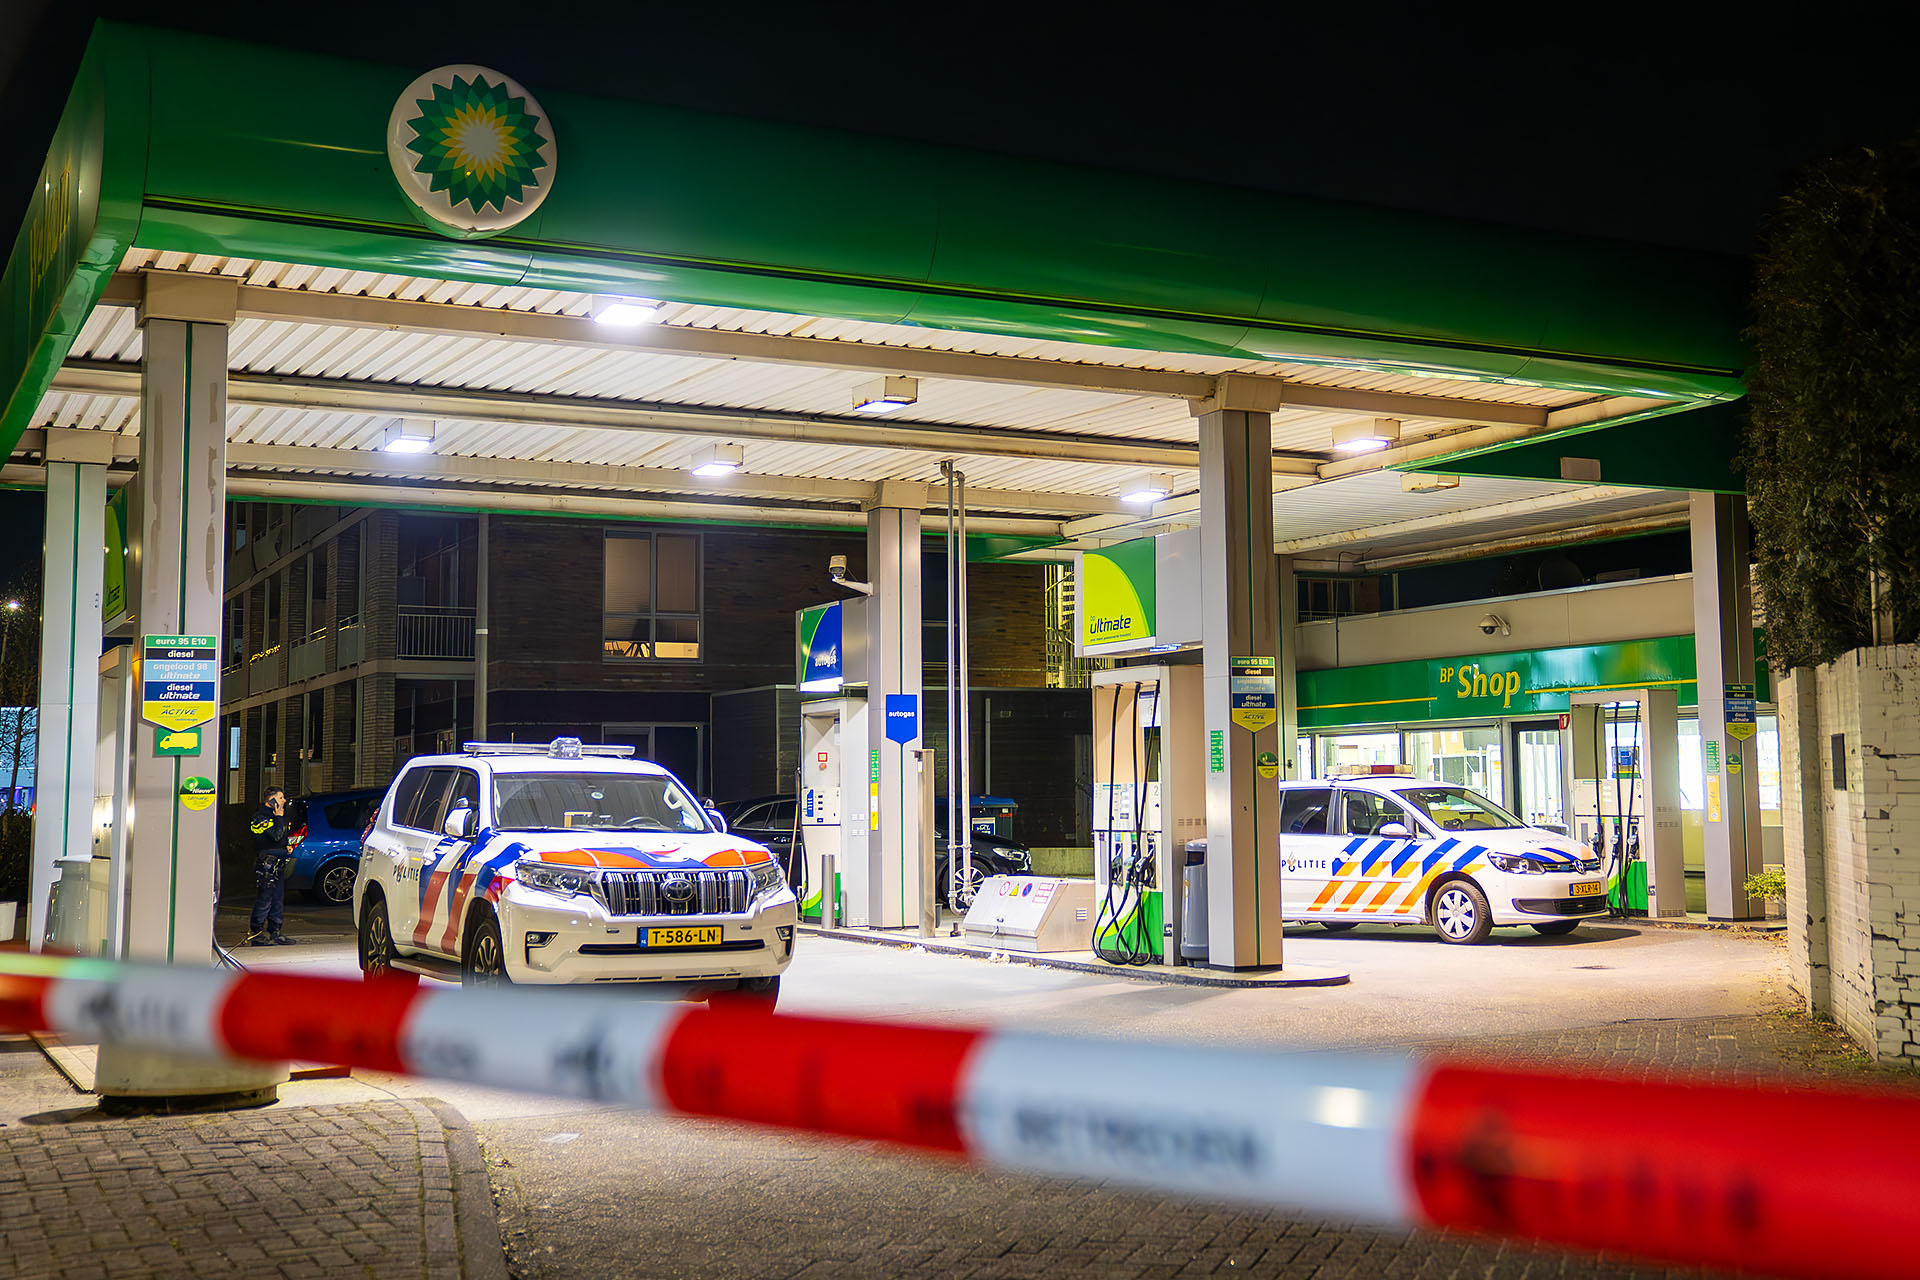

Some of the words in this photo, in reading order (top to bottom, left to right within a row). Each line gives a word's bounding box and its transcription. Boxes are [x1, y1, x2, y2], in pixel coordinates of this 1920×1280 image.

[1090, 614, 1131, 634] ultimate
[167, 650, 194, 658] diesel
[153, 663, 195, 671] ongelood
[160, 672, 201, 680] ultimate
[166, 683, 193, 691] diesel
[1440, 667, 1454, 683] BP
[1457, 664, 1520, 708] Shop
[159, 692, 201, 700] ultimate
[161, 708, 198, 716] ACTIVE
[888, 710, 915, 719] autogas
[1281, 859, 1327, 872] POLITIE
[393, 864, 419, 882] POLITIE
[652, 929, 716, 944] T-586-LN
